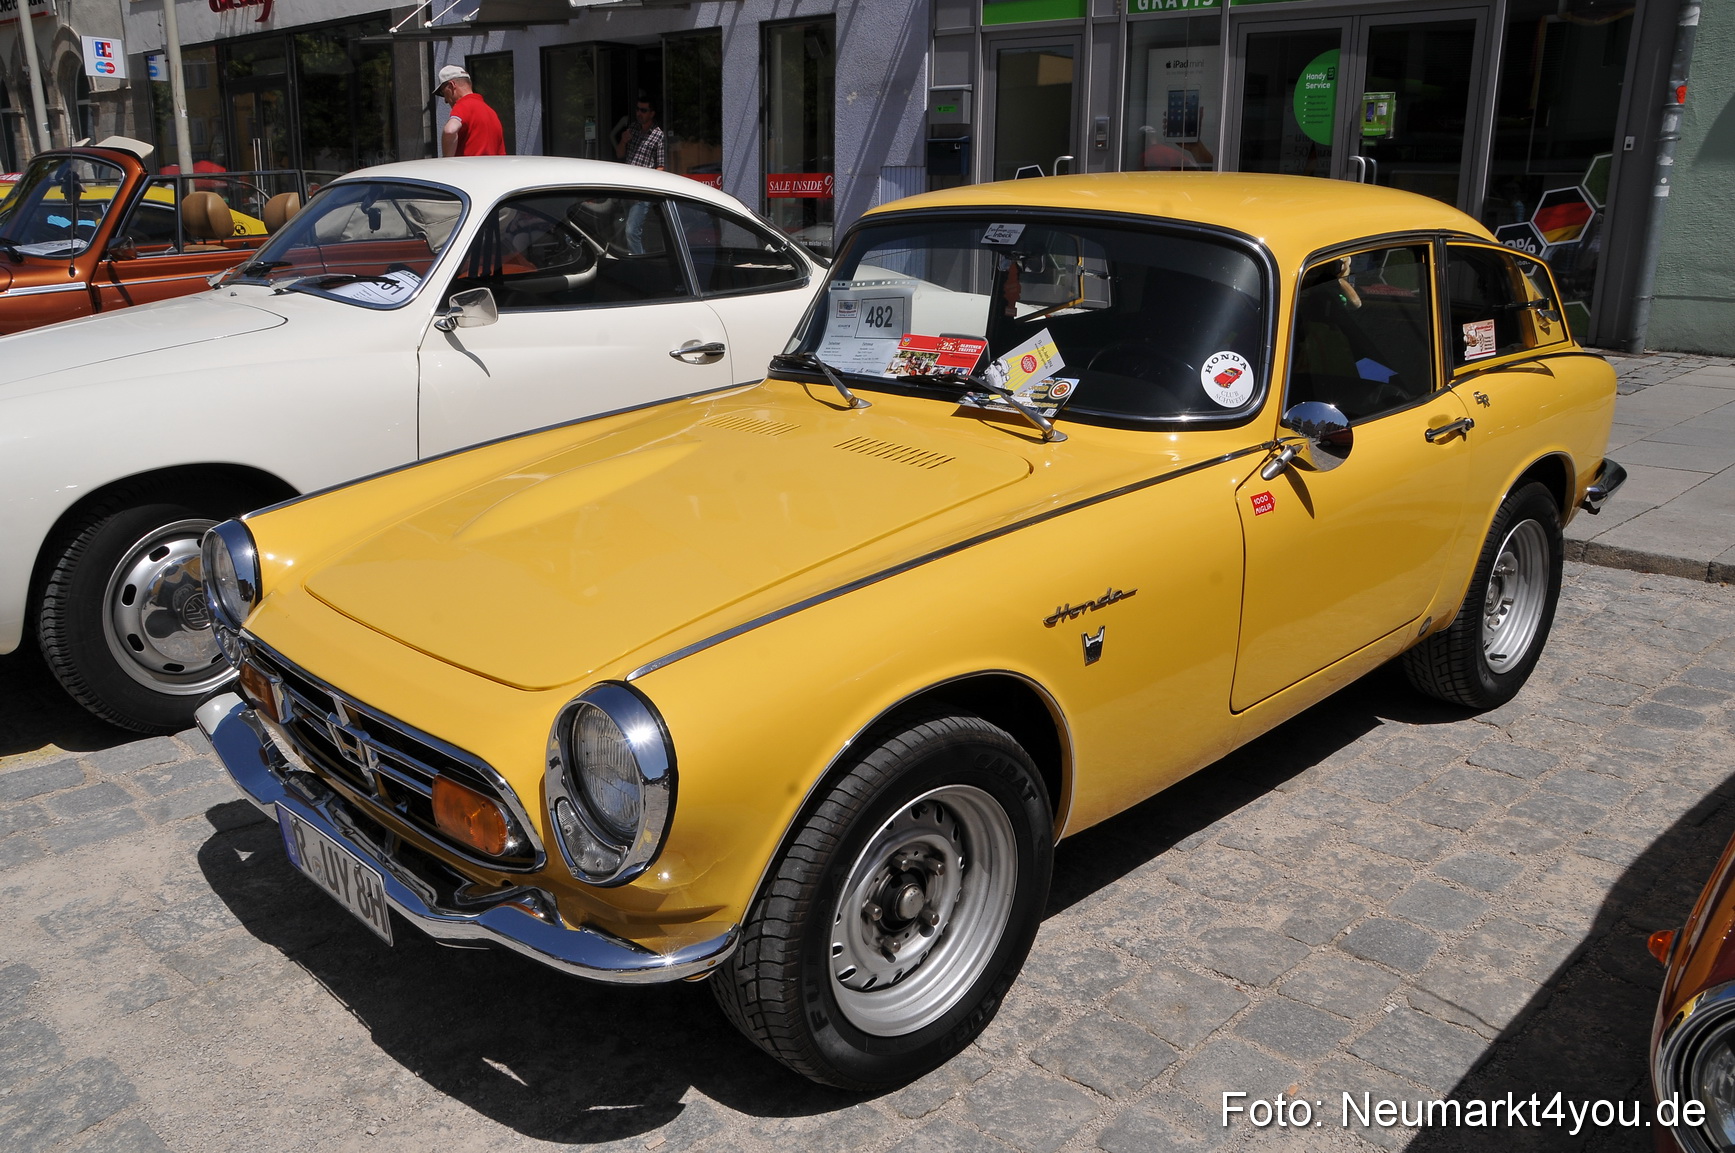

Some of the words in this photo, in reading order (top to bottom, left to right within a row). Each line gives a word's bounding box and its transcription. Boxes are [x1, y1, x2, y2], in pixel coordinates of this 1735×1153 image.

[1173, 59, 1189, 68] iPad
[1306, 73, 1327, 81] Handy
[1305, 82, 1331, 90] Service
[769, 180, 791, 191] SALE
[792, 180, 823, 191] INSIDE
[371, 280, 405, 295] 01
[865, 305, 893, 328] 482
[1205, 354, 1247, 374] HONDA
[1253, 494, 1269, 505] 1000
[1042, 586, 1138, 627] Honda
[974, 753, 1038, 802] CARAT
[292, 821, 313, 873] R
[319, 840, 351, 904] UY
[353, 864, 388, 935] 8H
